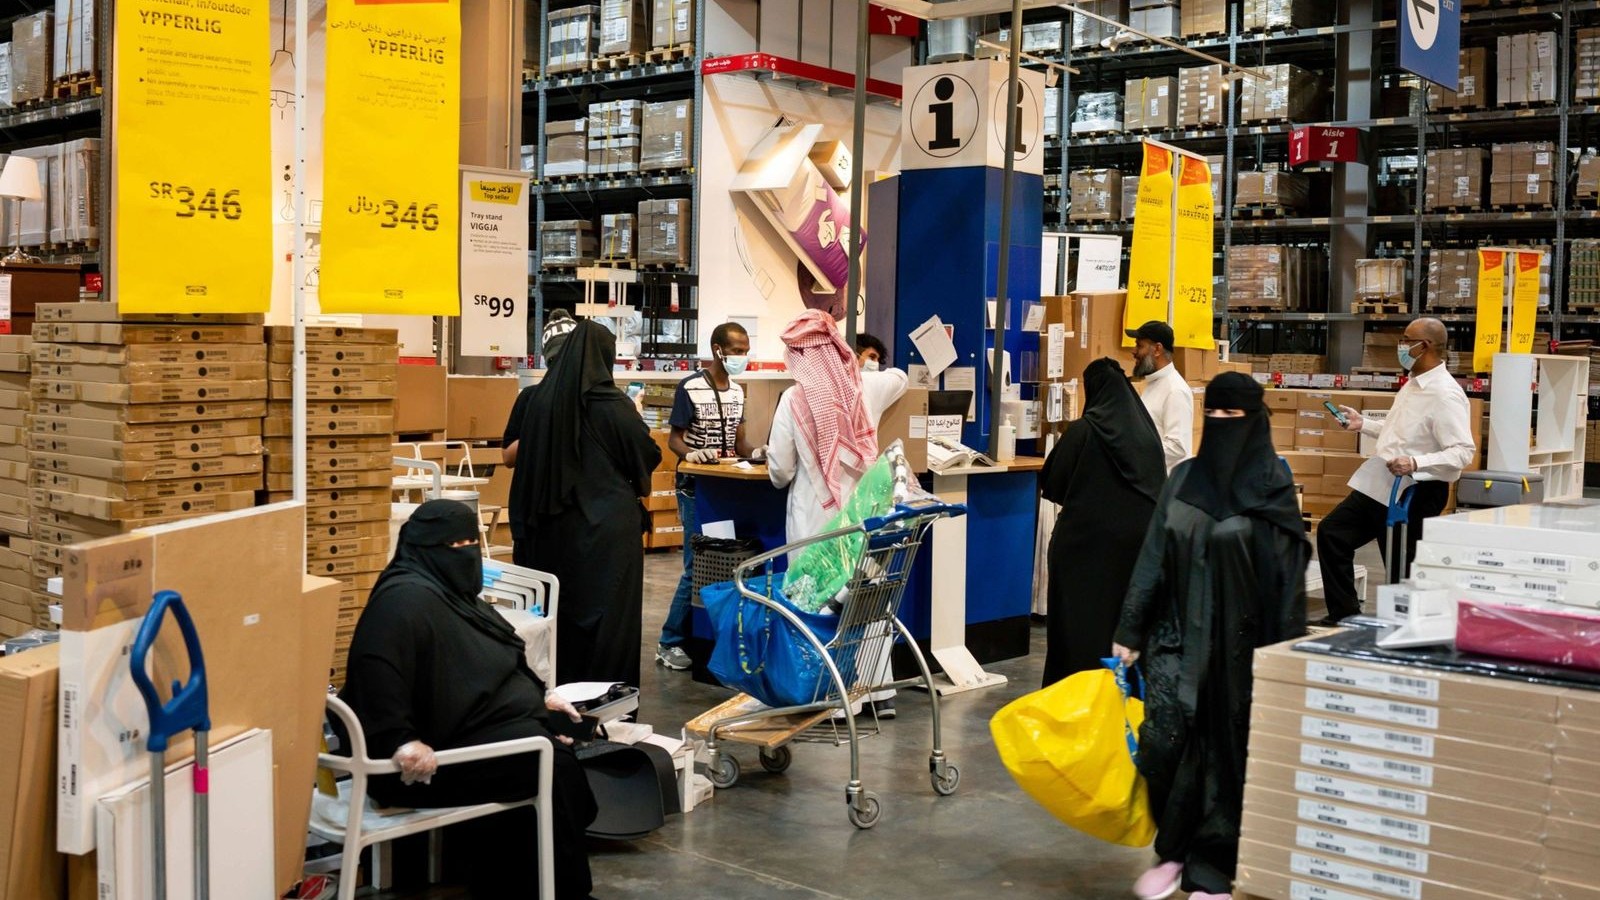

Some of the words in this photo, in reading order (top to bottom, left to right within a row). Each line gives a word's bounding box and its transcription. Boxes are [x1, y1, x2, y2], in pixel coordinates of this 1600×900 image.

[197, 0, 251, 16] in/outdoor
[139, 10, 222, 34] YPPERLIG
[368, 38, 444, 65] YPPERLIG
[1322, 129, 1345, 137] Aisle
[1296, 142, 1302, 160] 1
[1326, 140, 1339, 158] 1
[150, 181, 173, 199] SR
[175, 186, 242, 221] 346
[380, 199, 440, 232] 346
[470, 212, 484, 220] Tray
[485, 213, 503, 221] stand
[470, 222, 498, 232] VIGGJA
[1144, 281, 1162, 300] 275
[1189, 286, 1207, 304] 275
[474, 294, 488, 306] SR
[488, 297, 515, 318] 99
